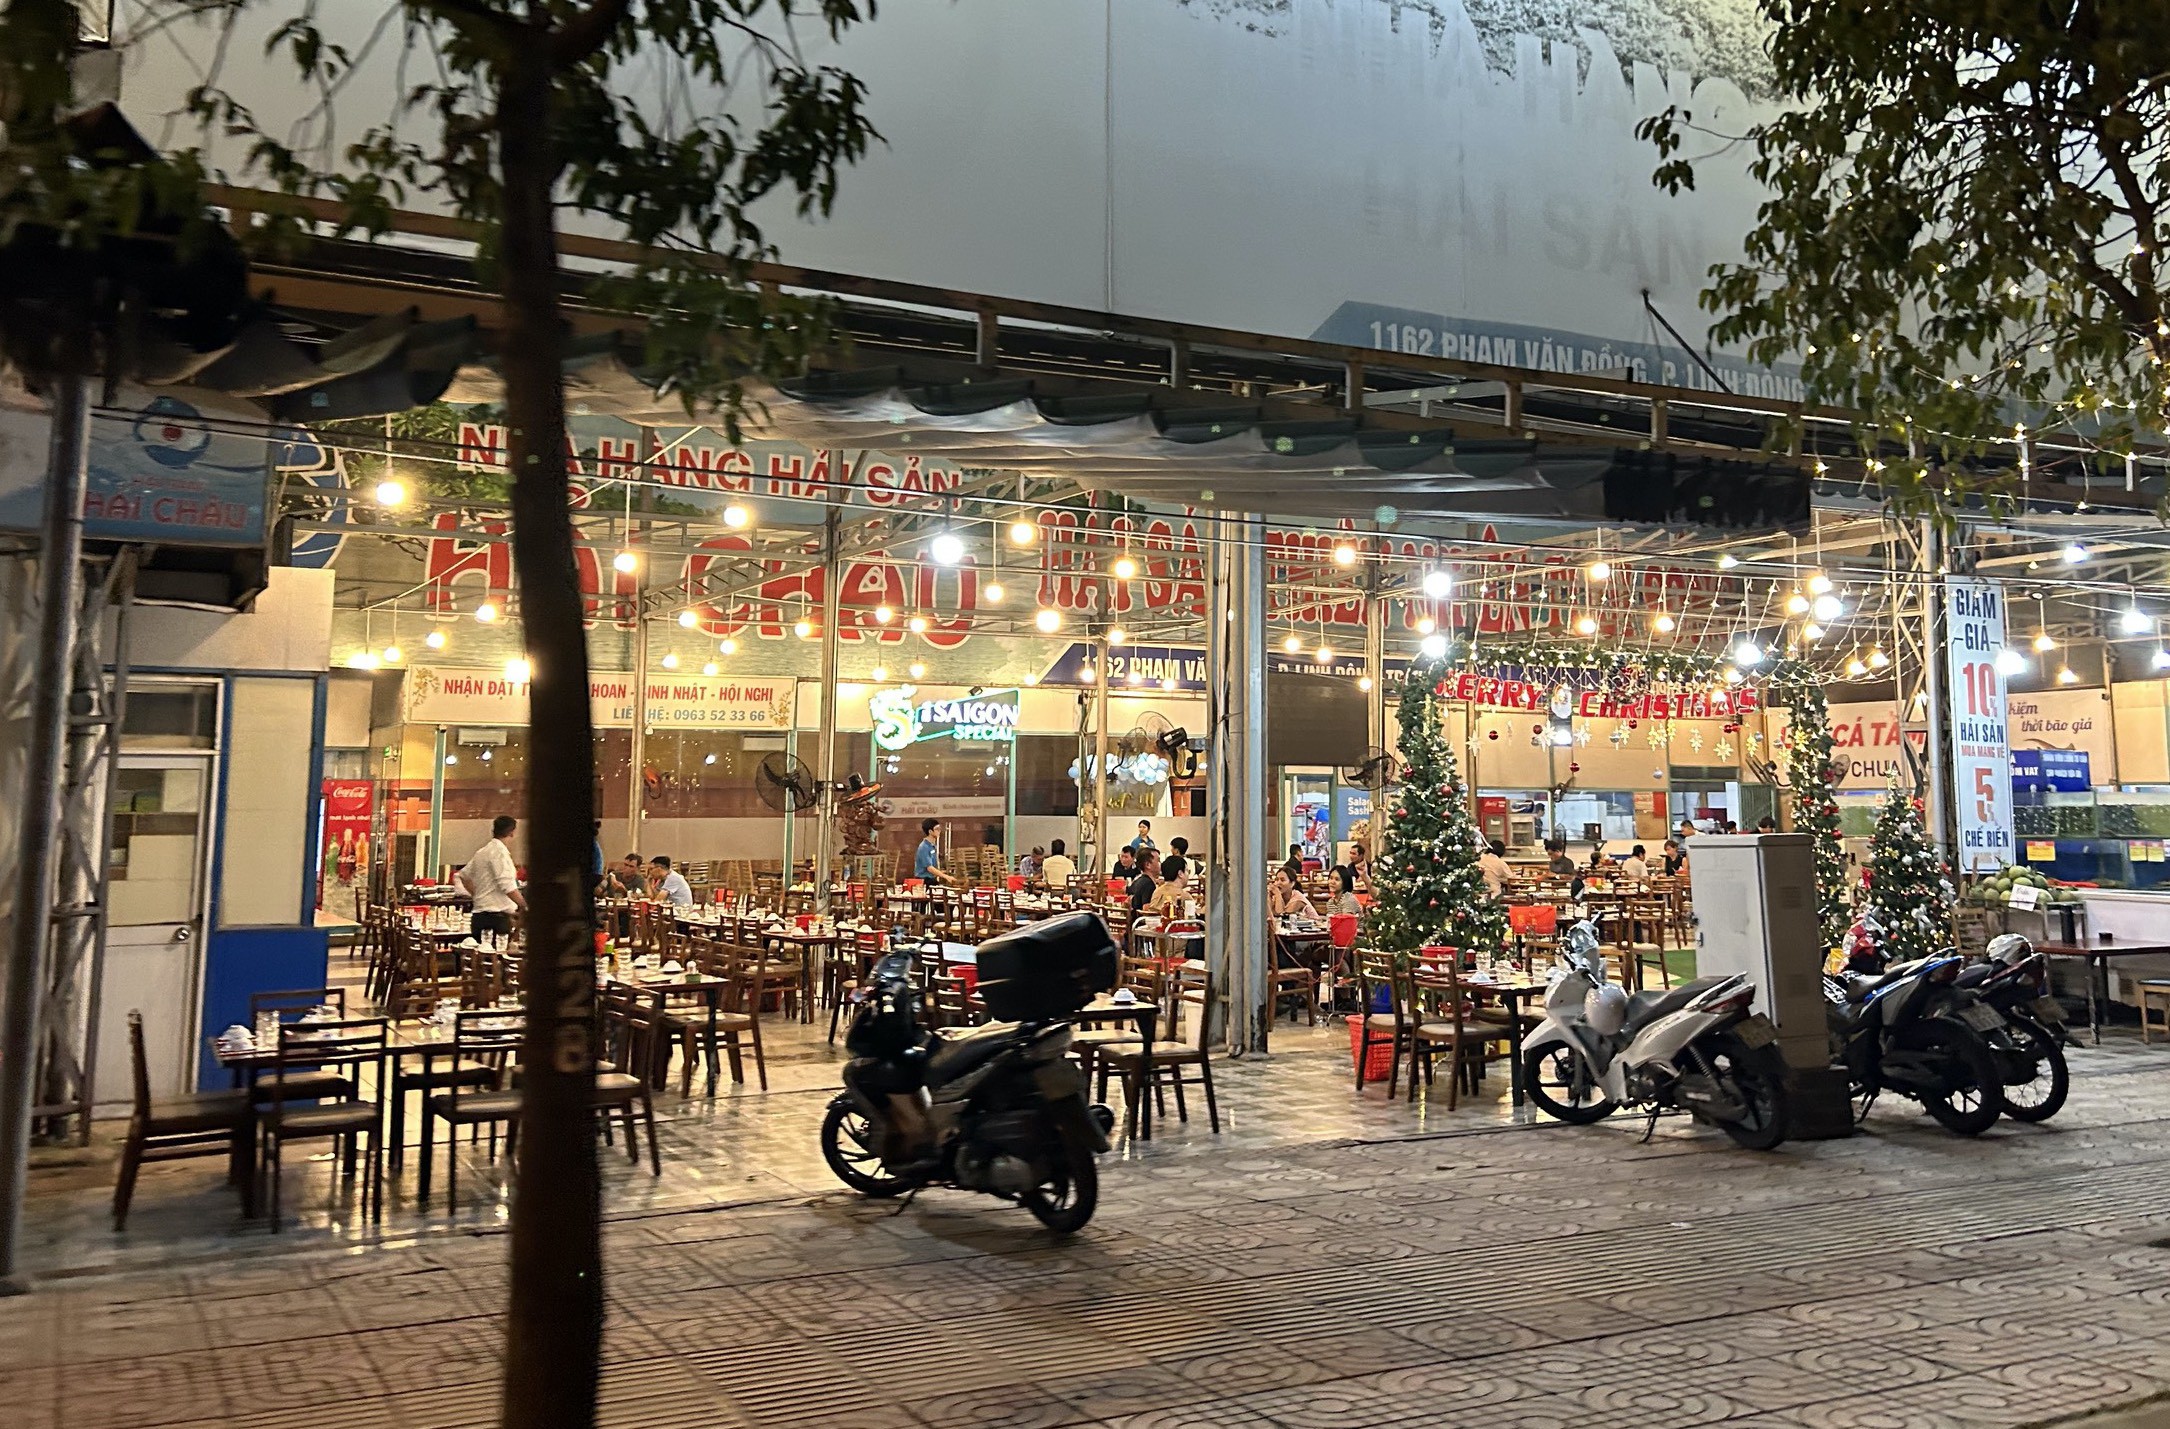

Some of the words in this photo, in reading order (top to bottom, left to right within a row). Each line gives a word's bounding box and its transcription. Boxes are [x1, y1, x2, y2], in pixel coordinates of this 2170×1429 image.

[1371, 321, 1434, 357] 1162
[1523, 337, 1574, 374] VĂN
[768, 448, 852, 502] HẢI
[864, 455, 963, 513] SẢN
[153, 496, 248, 529] CHÂU
[1143, 503, 1207, 622] SẢ
[1964, 620, 1991, 652] GIÁ
[1185, 656, 1207, 682] VĂ
[444, 676, 483, 698] NHẬN
[647, 685, 669, 700] INH
[673, 682, 708, 702] NHẬT
[719, 683, 741, 704] HỘI
[613, 707, 633, 720] LIÊ
[674, 709, 705, 721] 0963
[710, 709, 726, 721] 52
[730, 710, 746, 722] 33
[749, 710, 766, 722] 66
[933, 701, 1018, 725] SAIGON
[2071, 717, 2093, 734] giá
[953, 724, 1014, 741] SPECIAL
[1832, 716, 1865, 748] CÁ
[1960, 717, 1979, 743] HẢI
[1982, 719, 2004, 744] SẢN
[1965, 825, 1984, 848] CHẾ
[1986, 826, 2010, 848] BIẾN
